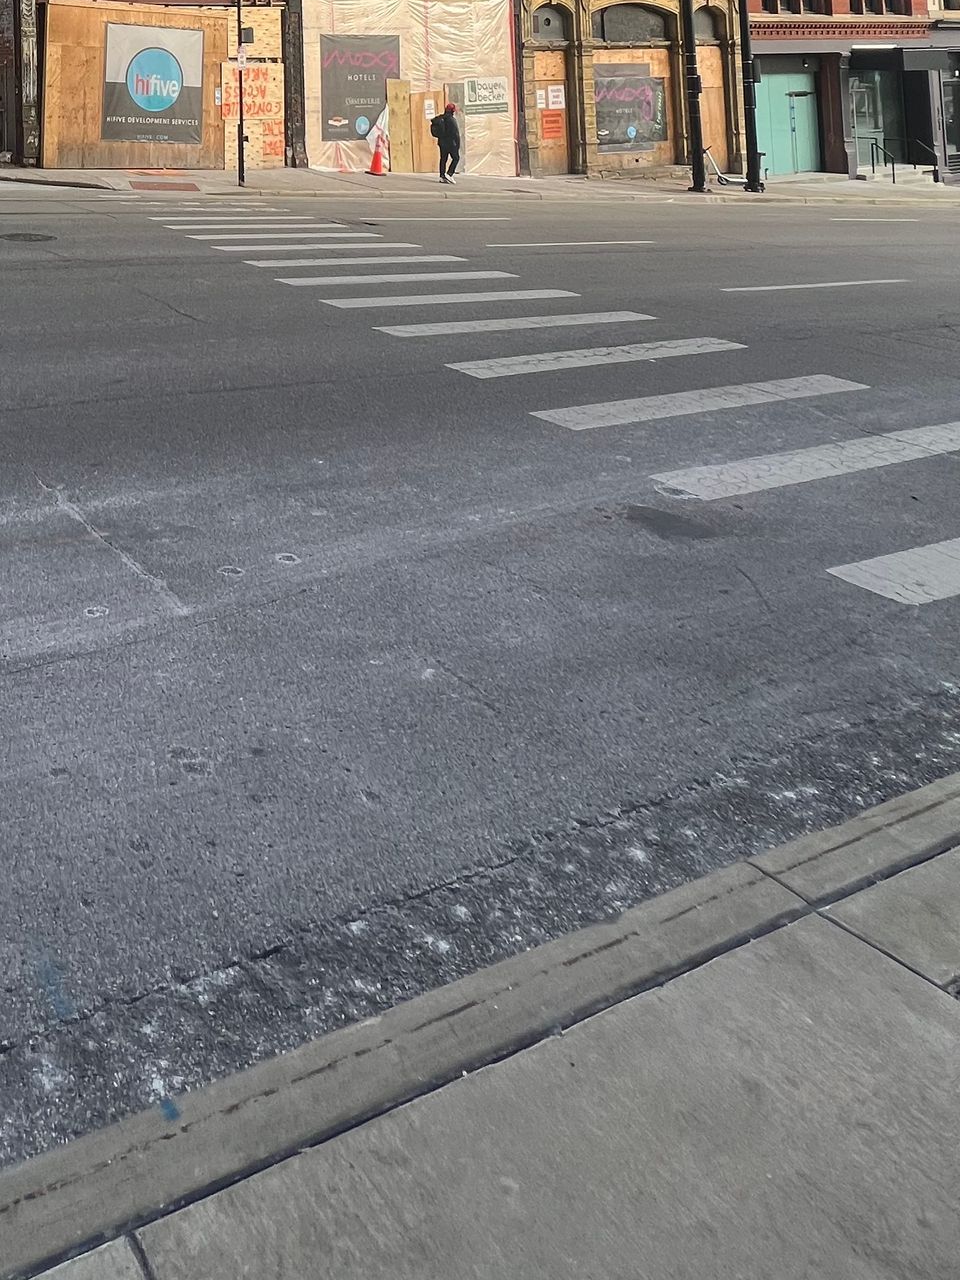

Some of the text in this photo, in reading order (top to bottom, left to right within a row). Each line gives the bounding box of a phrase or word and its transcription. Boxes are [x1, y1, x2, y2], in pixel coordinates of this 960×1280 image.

[135, 74, 179, 97] hifive
[477, 80, 502, 94] bayer
[478, 91, 505, 102] becker
[127, 116, 170, 124] DEVELOPMENT
[171, 118, 199, 126] SERVICES
